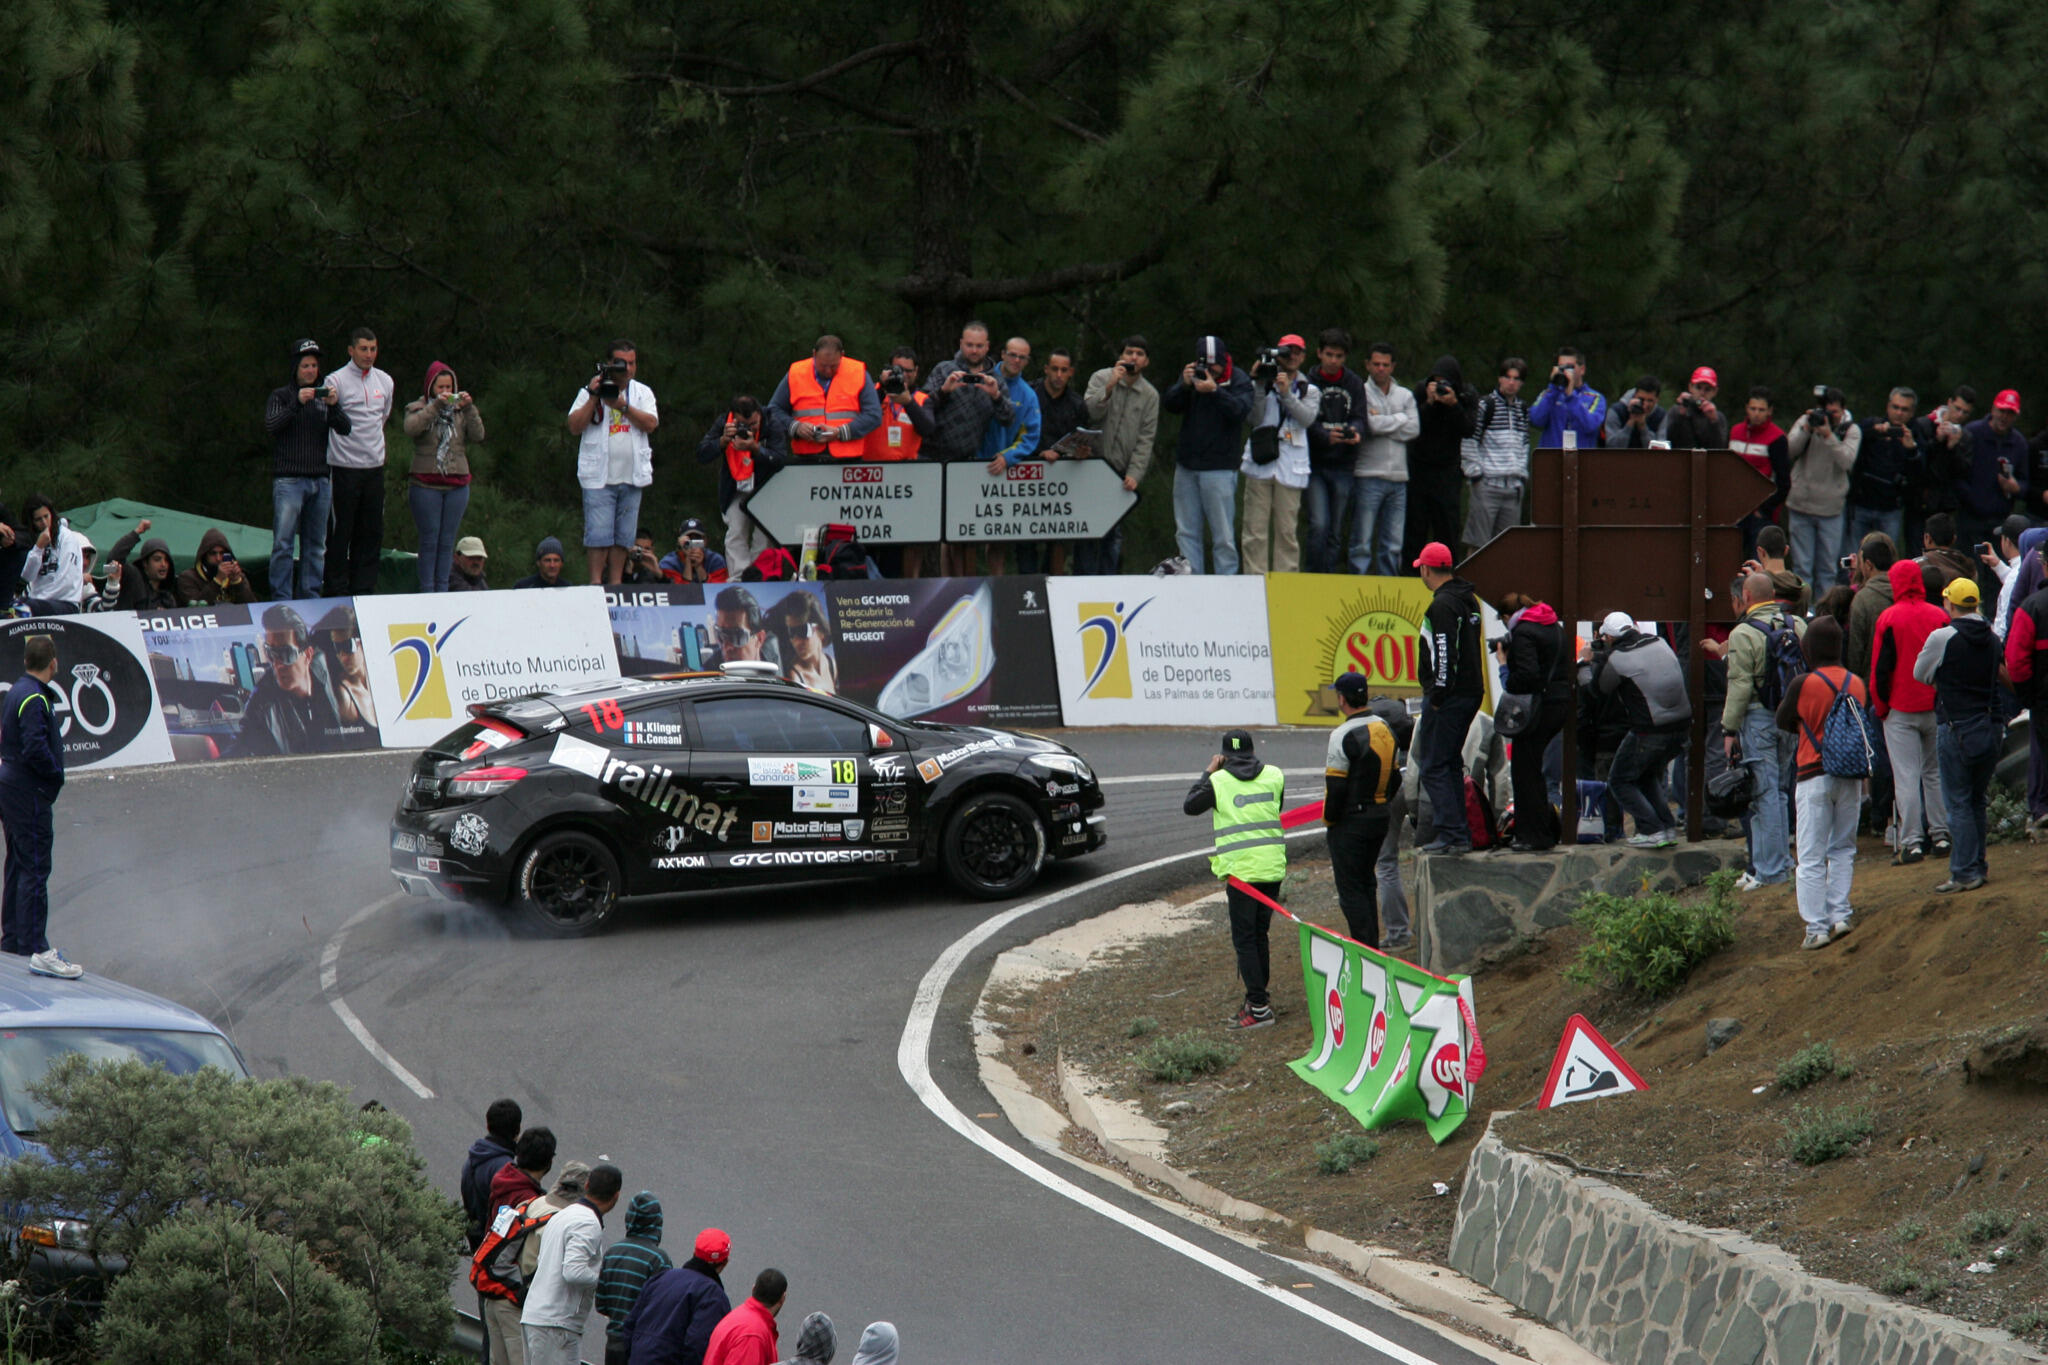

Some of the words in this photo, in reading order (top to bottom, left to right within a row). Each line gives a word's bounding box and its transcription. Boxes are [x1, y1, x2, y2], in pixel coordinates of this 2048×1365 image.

[843, 468, 882, 481] GC-70
[1007, 466, 1042, 479] GC-21
[810, 485, 913, 501] FONTANALES
[981, 482, 1069, 498] VALLESECO
[840, 505, 883, 519] MOYA
[975, 503, 1003, 518] LAS
[1012, 502, 1072, 517] PALMAS
[855, 524, 892, 539] DAR
[959, 523, 976, 536] DE
[984, 522, 1022, 536] GRAN
[1029, 521, 1089, 534] CANARIA
[605, 592, 670, 607] OLICE
[836, 596, 853, 606] Ven
[854, 598, 861, 606] a
[861, 596, 875, 605] GC
[876, 595, 910, 605] MOTOR
[846, 607, 883, 617] descubrir
[885, 607, 893, 616] la
[37, 622, 46, 631] DE
[46, 622, 65, 632] BODA
[138, 614, 219, 632] POLICE
[841, 617, 902, 629] Re-Generación
[904, 617, 915, 627] de
[842, 631, 885, 642] PEUGEOT
[1140, 641, 1199, 658] Instituto
[1203, 641, 1271, 661] Municipa
[457, 659, 522, 678] Instituto
[527, 653, 606, 675] Municipal
[1435, 633, 1448, 687] Kawasaki
[1142, 667, 1159, 682] de
[1163, 665, 1232, 686] Deportes
[461, 685, 480, 702] de
[1144, 688, 1162, 699] Las
[1164, 687, 1200, 699] Palmas
[1202, 688, 1214, 699] de
[1216, 687, 1241, 699] Gran
[580, 698, 625, 735] 18
[636, 721, 682, 734] N.Klinger
[636, 733, 682, 745] R.Consani
[752, 772, 795, 782] Canarias
[833, 760, 855, 784] 18
[603, 758, 739, 843] railmat
[657, 856, 705, 869] AX'HOM
[729, 853, 774, 866] GTC
[774, 849, 898, 864] MOTORSPORT
